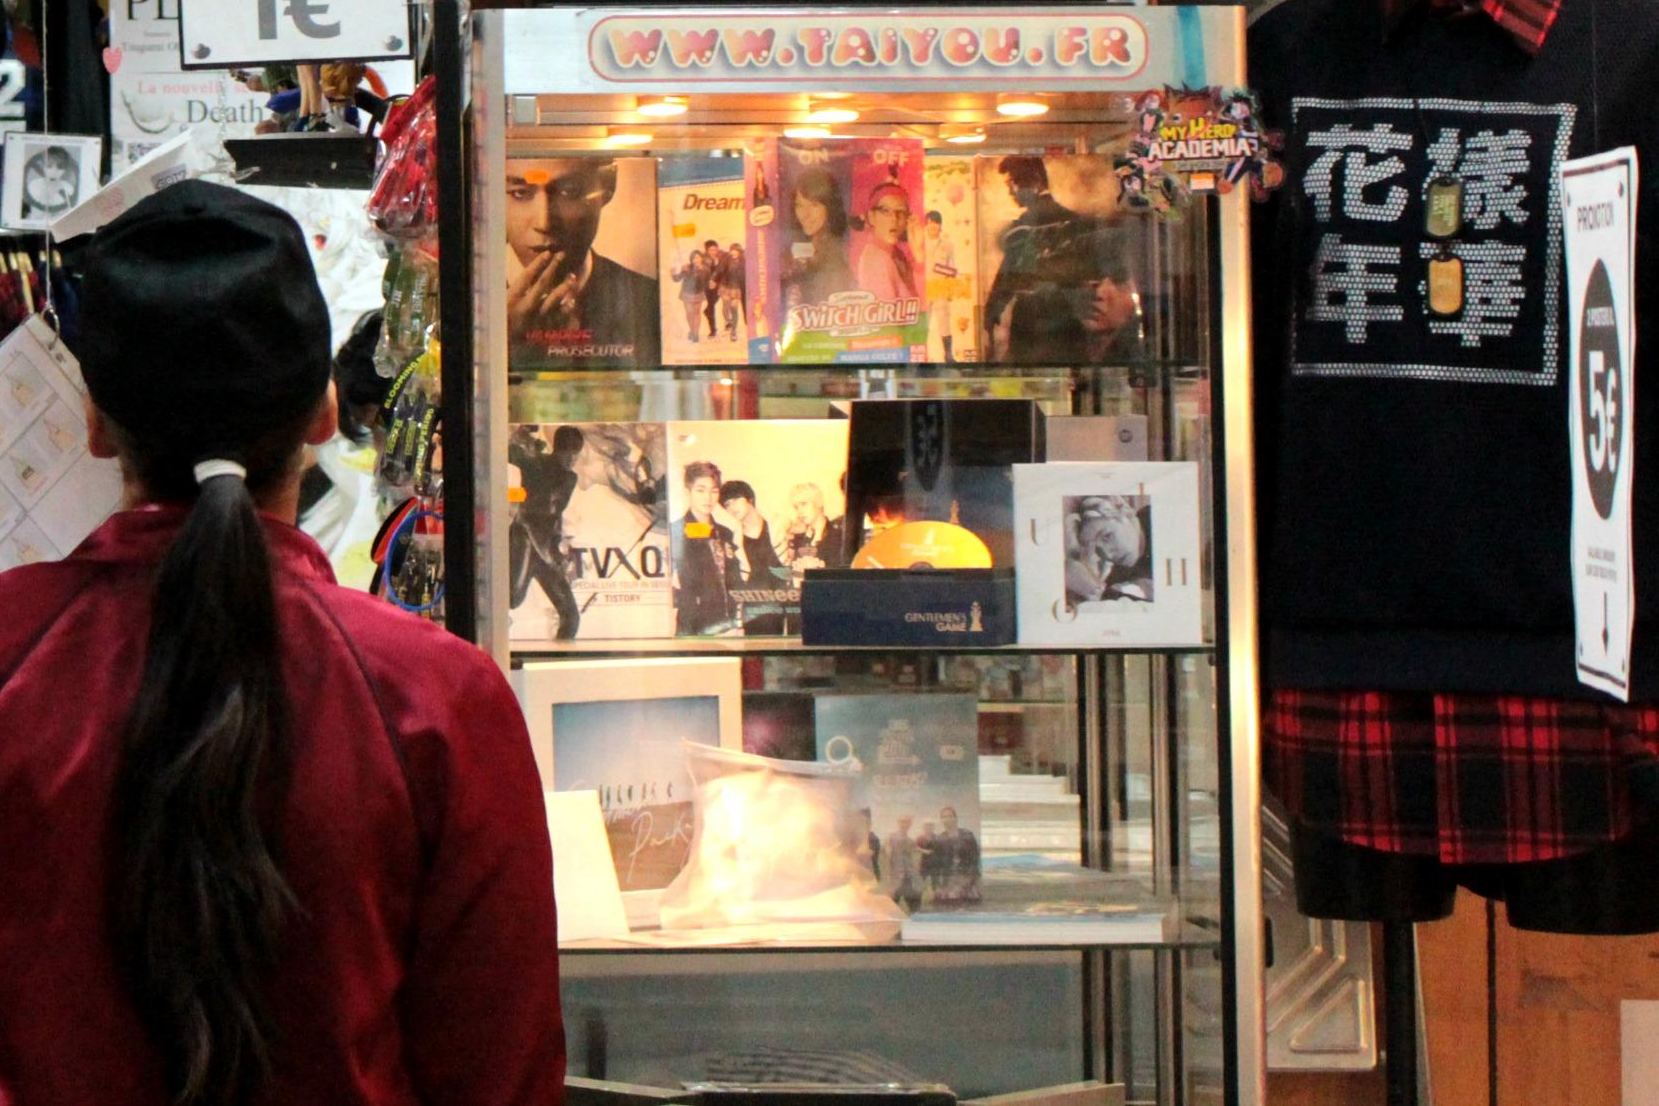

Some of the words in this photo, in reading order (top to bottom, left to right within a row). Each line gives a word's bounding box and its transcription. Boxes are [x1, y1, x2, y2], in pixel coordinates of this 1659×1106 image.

[608, 25, 1133, 68] WWW.TAIYOU.FR
[186, 98, 265, 124] Death
[1159, 125, 1187, 141] MY
[797, 148, 830, 165] ON
[872, 148, 910, 167] OFF
[1147, 137, 1253, 162] ACADEMIA
[682, 192, 745, 211] Dream
[547, 344, 635, 358] PROSECUTOR
[935, 622, 967, 633] GAME
